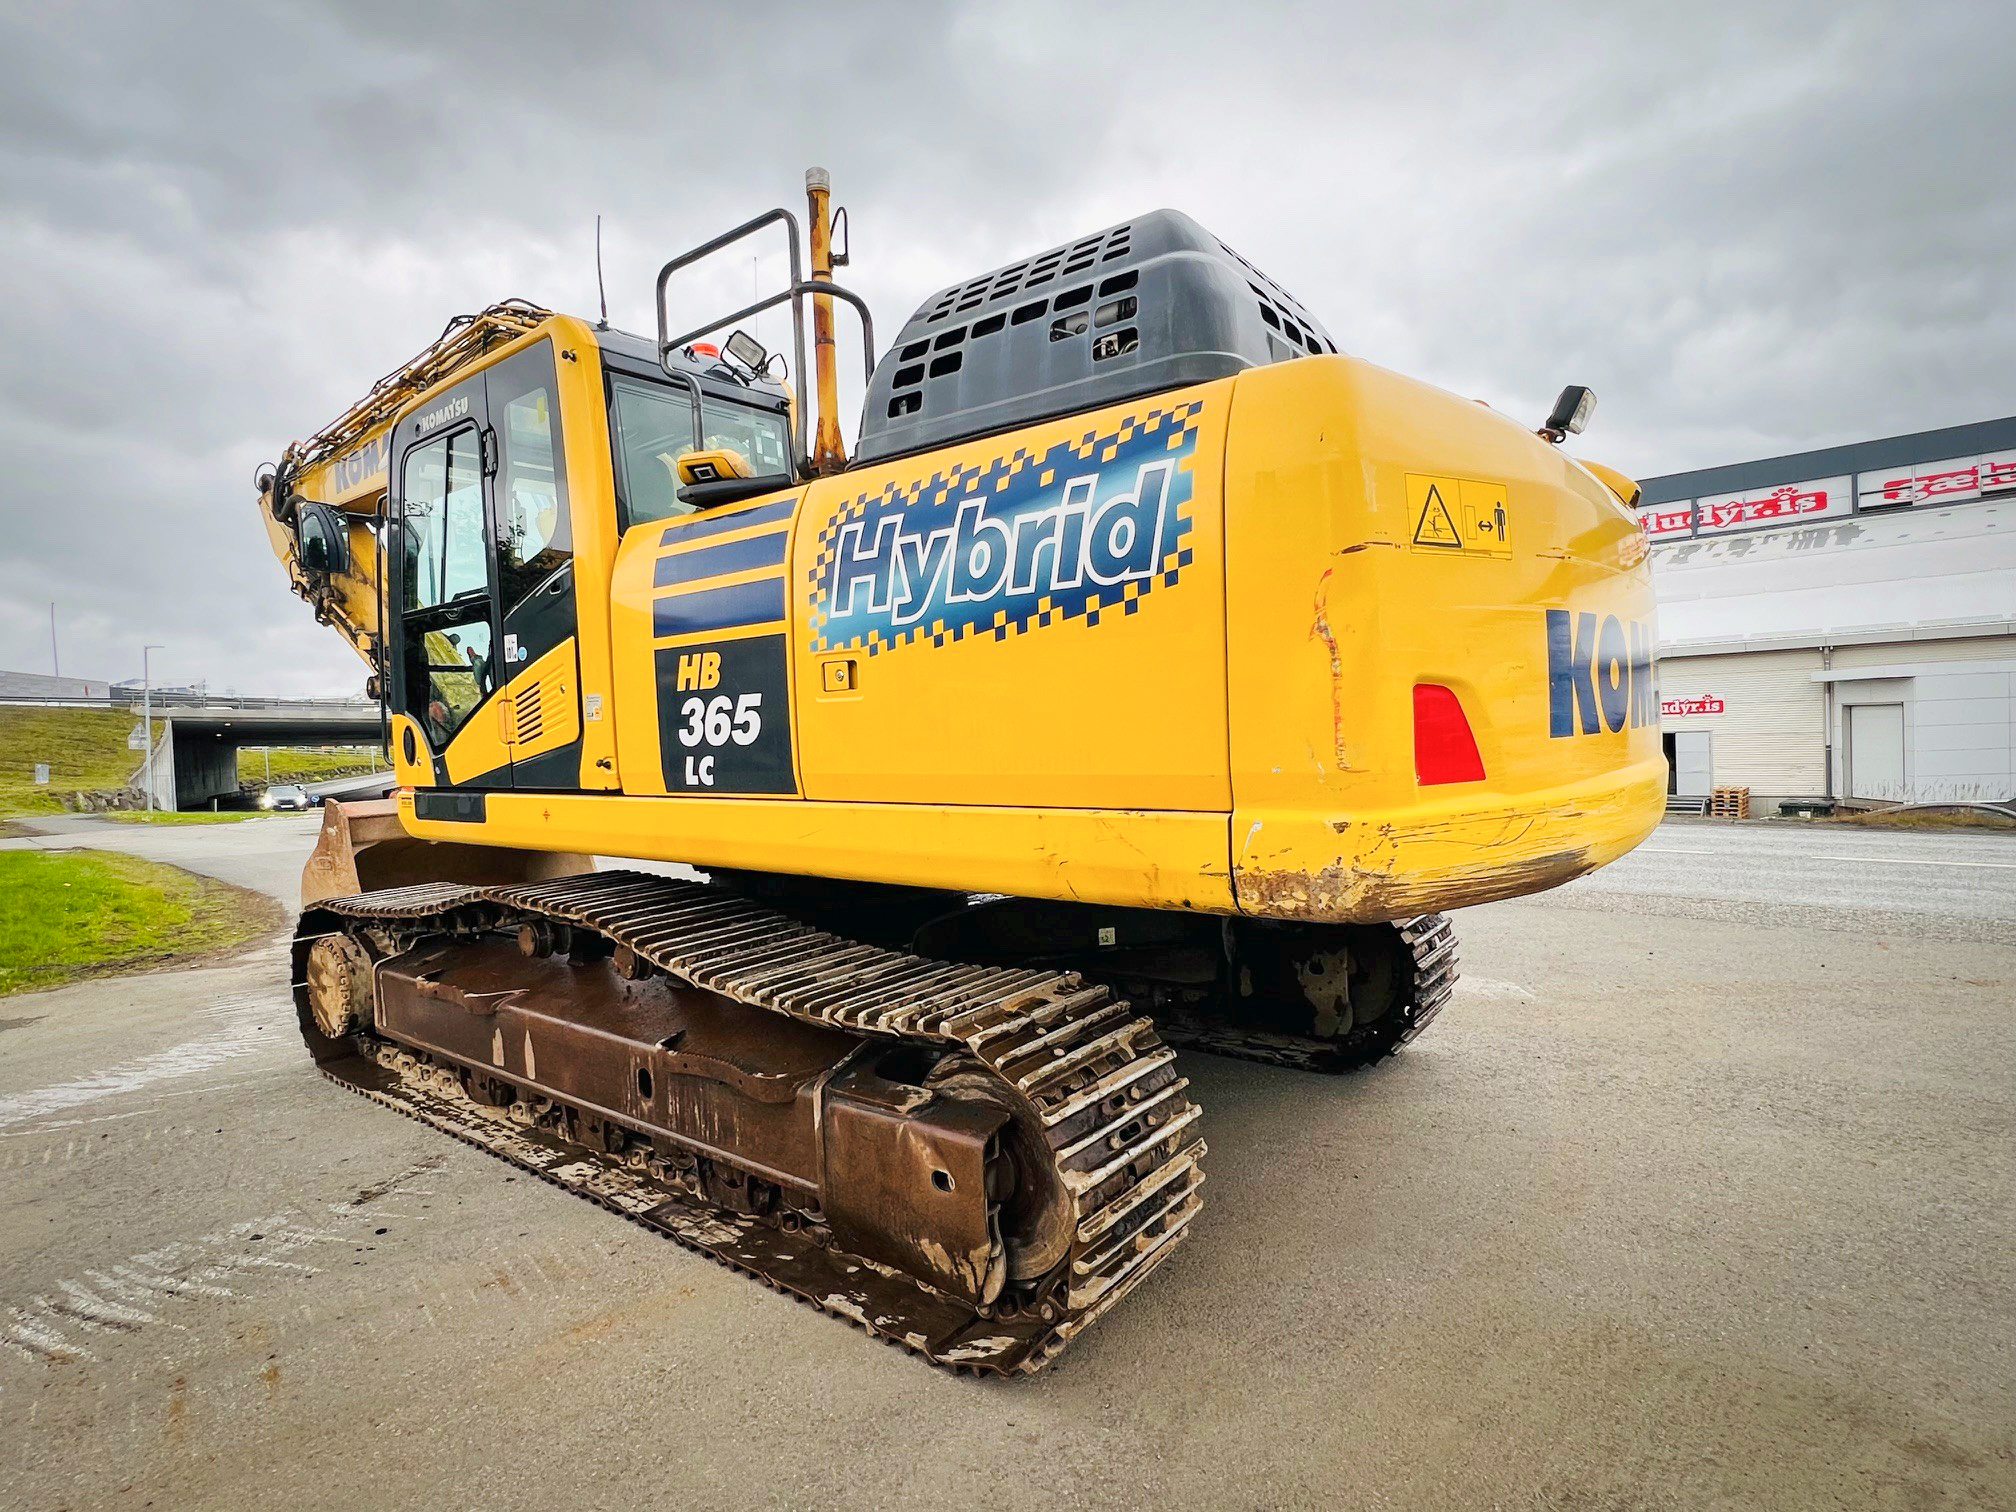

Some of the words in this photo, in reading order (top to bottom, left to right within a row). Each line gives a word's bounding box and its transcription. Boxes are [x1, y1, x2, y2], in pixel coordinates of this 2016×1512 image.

[421, 396, 469, 433] KOMATSU
[830, 457, 1176, 626] Hybrid
[677, 652, 722, 692] HB
[678, 692, 763, 747] 365
[685, 754, 715, 787] LC
